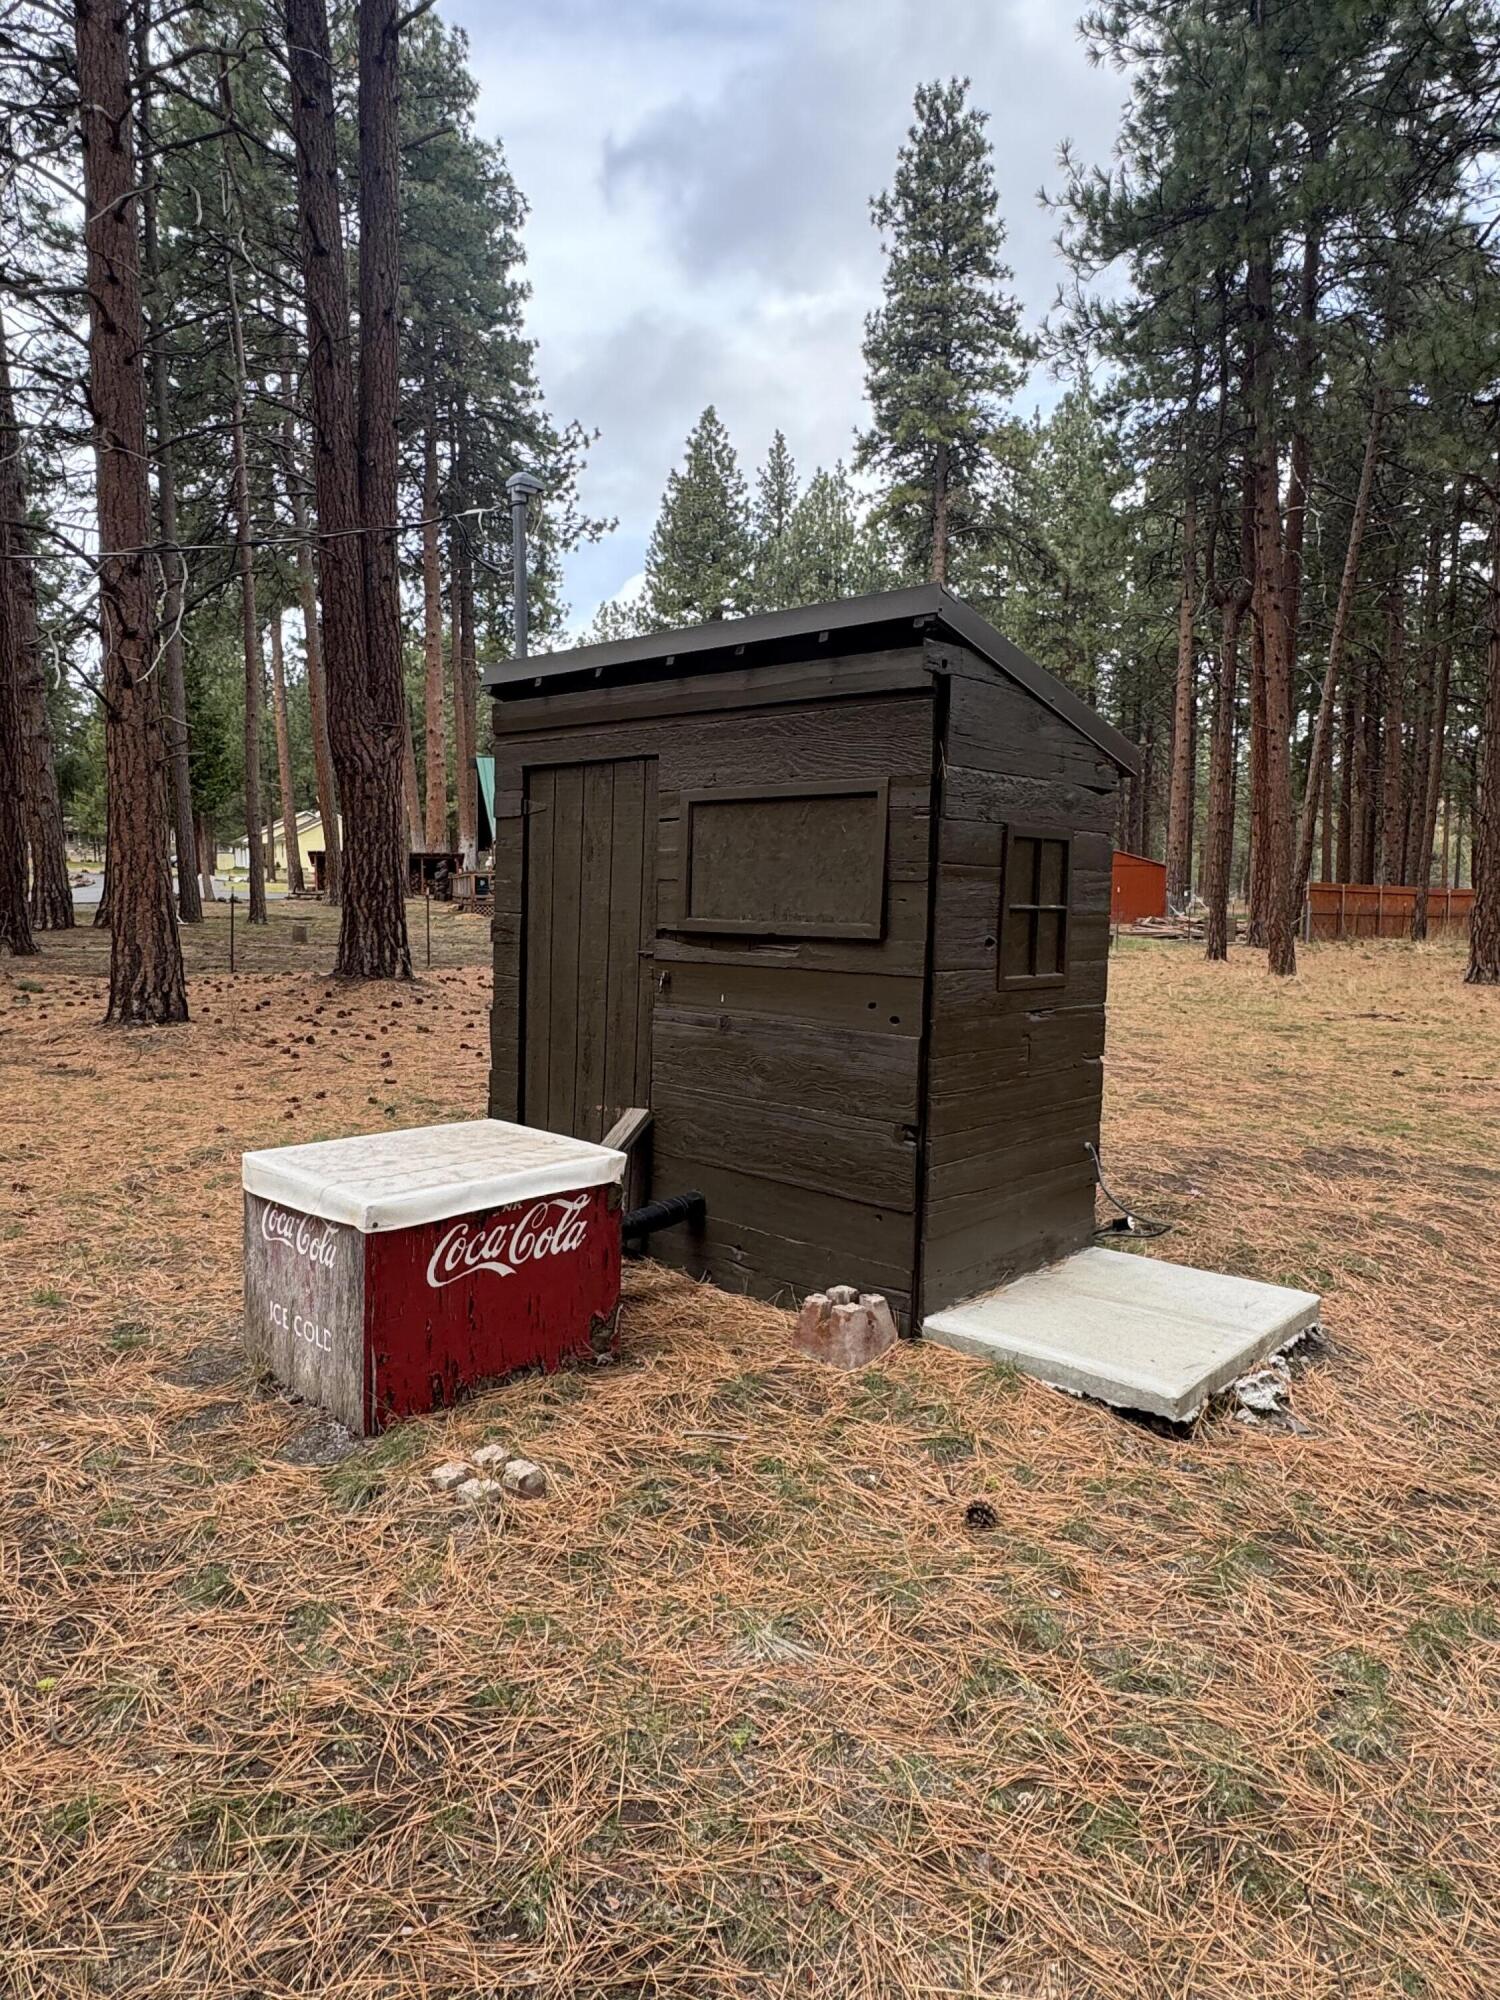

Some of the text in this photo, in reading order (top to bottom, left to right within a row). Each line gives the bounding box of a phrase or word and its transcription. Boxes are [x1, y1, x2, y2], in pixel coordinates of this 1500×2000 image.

[261, 1201, 339, 1269] Coca-Cola
[426, 1194, 592, 1288] Coca-Cola
[269, 1300, 332, 1352] ICE COLD
